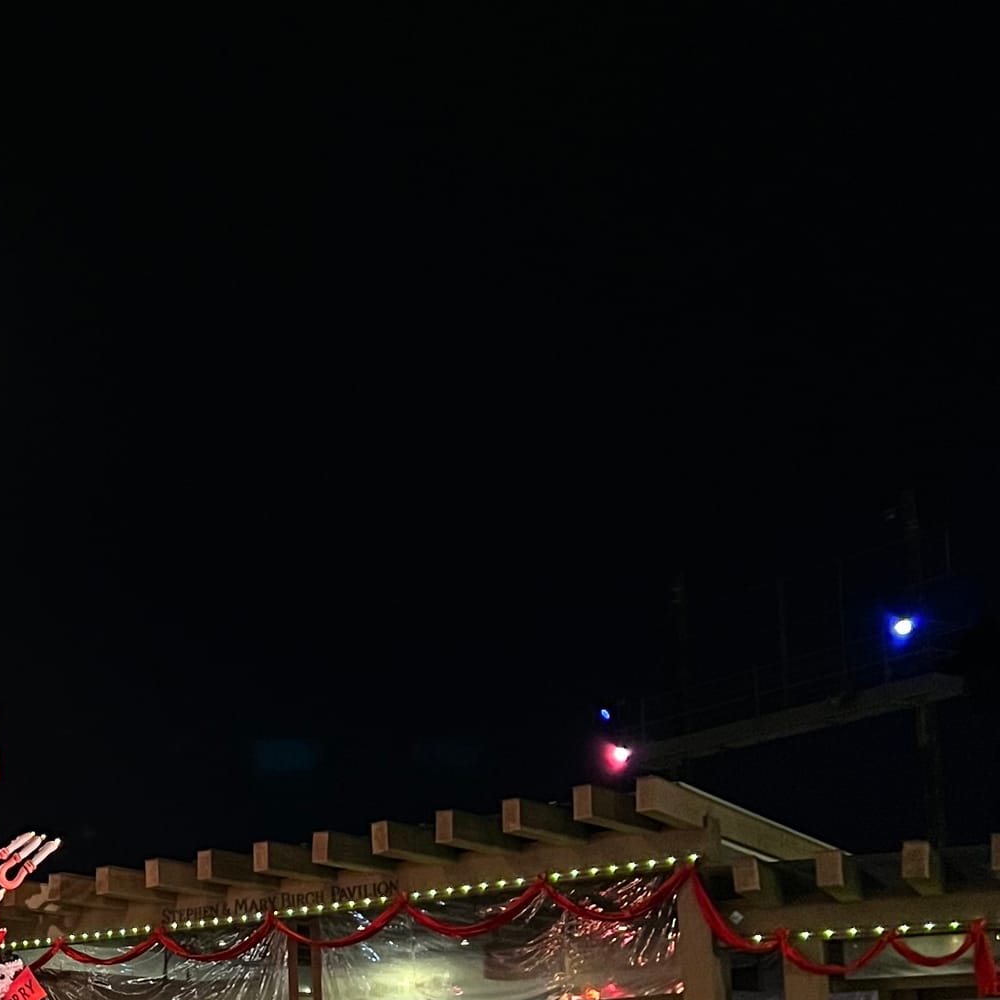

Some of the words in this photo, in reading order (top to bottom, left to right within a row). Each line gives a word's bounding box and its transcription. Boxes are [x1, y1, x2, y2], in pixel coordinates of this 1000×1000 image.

[161, 904, 219, 923] STEPHEN
[220, 904, 231, 918] &
[234, 896, 275, 915] MARY
[281, 889, 325, 908] BIRCH
[331, 879, 401, 900] PAVILION
